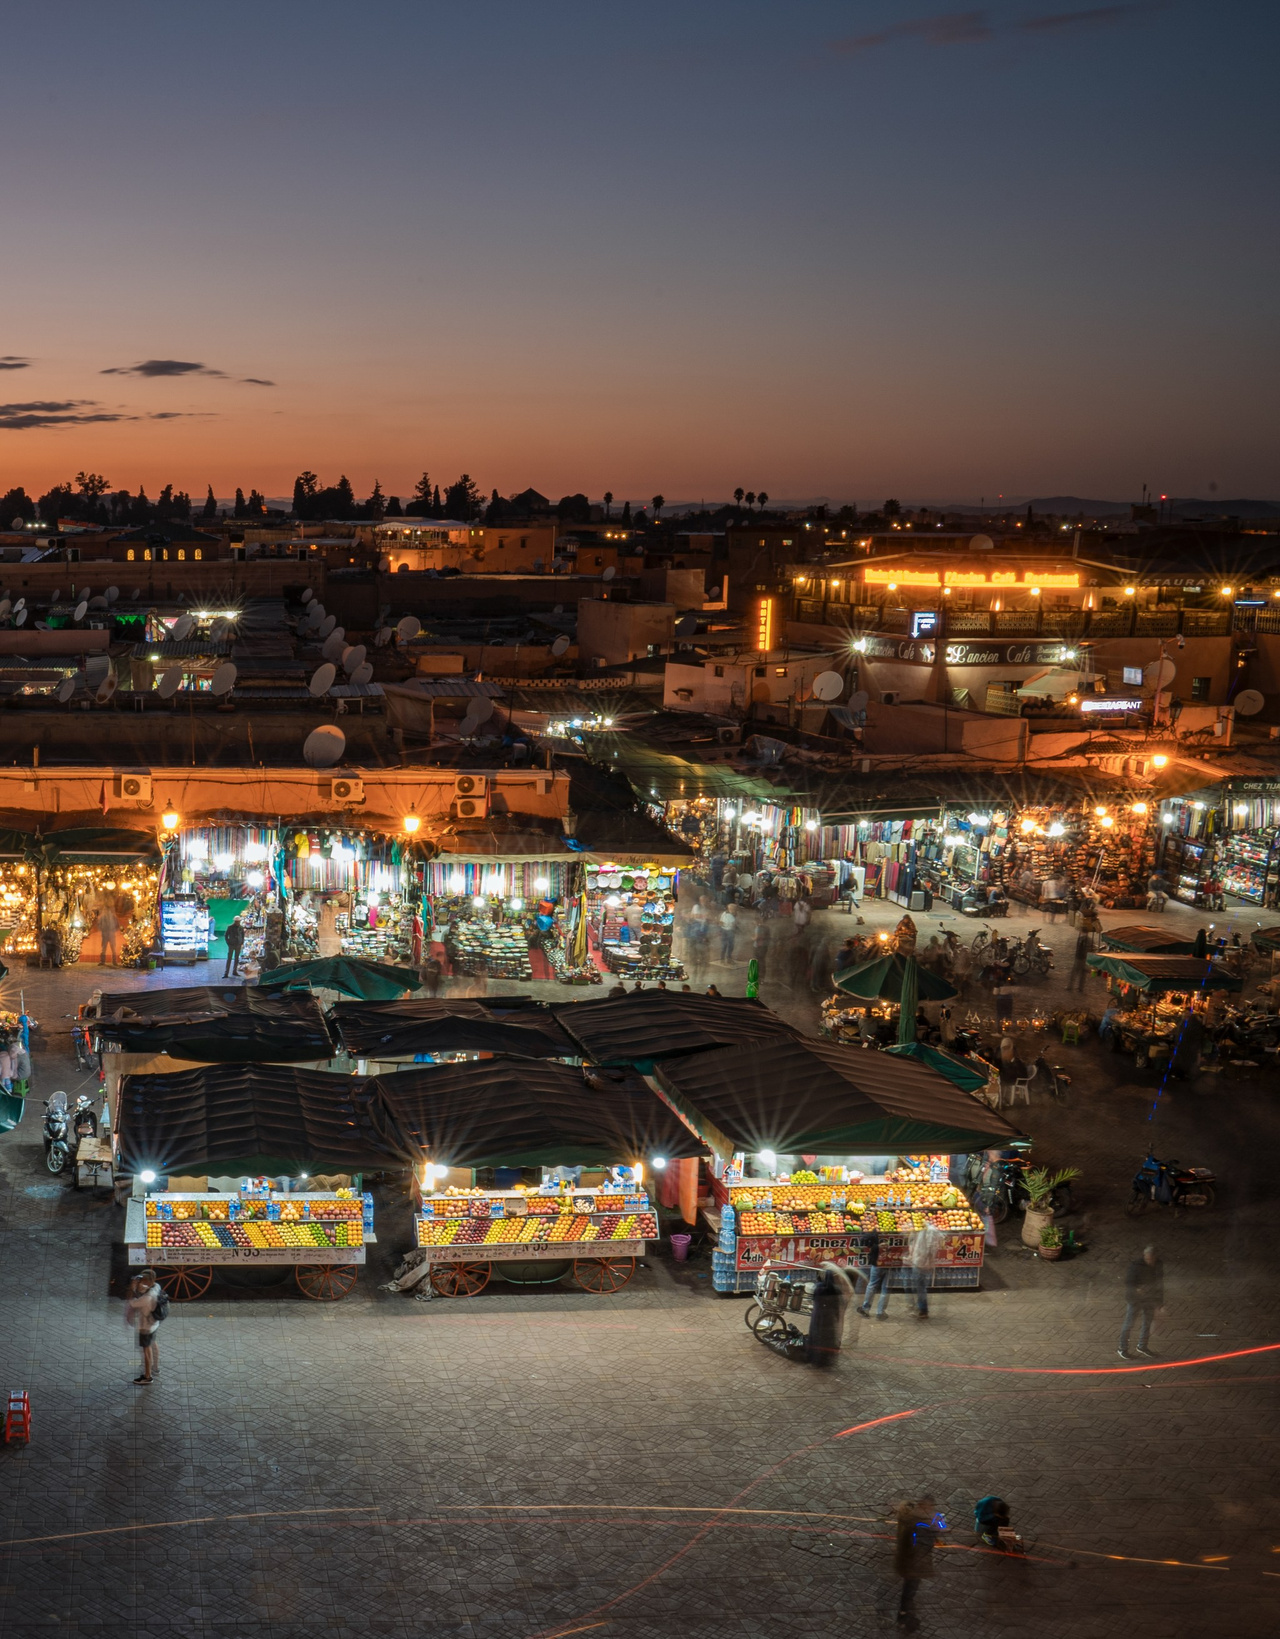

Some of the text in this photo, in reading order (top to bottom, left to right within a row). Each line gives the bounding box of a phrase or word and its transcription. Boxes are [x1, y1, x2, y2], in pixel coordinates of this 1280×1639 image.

[899, 641, 915, 660] Café
[951, 645, 999, 663] L'ancien
[1007, 645, 1031, 663] Café
[1243, 782, 1263, 790] CHEZ
[809, 1238, 847, 1248] Chez
[741, 1247, 764, 1263] 4dh
[956, 1244, 980, 1259] 4dh
